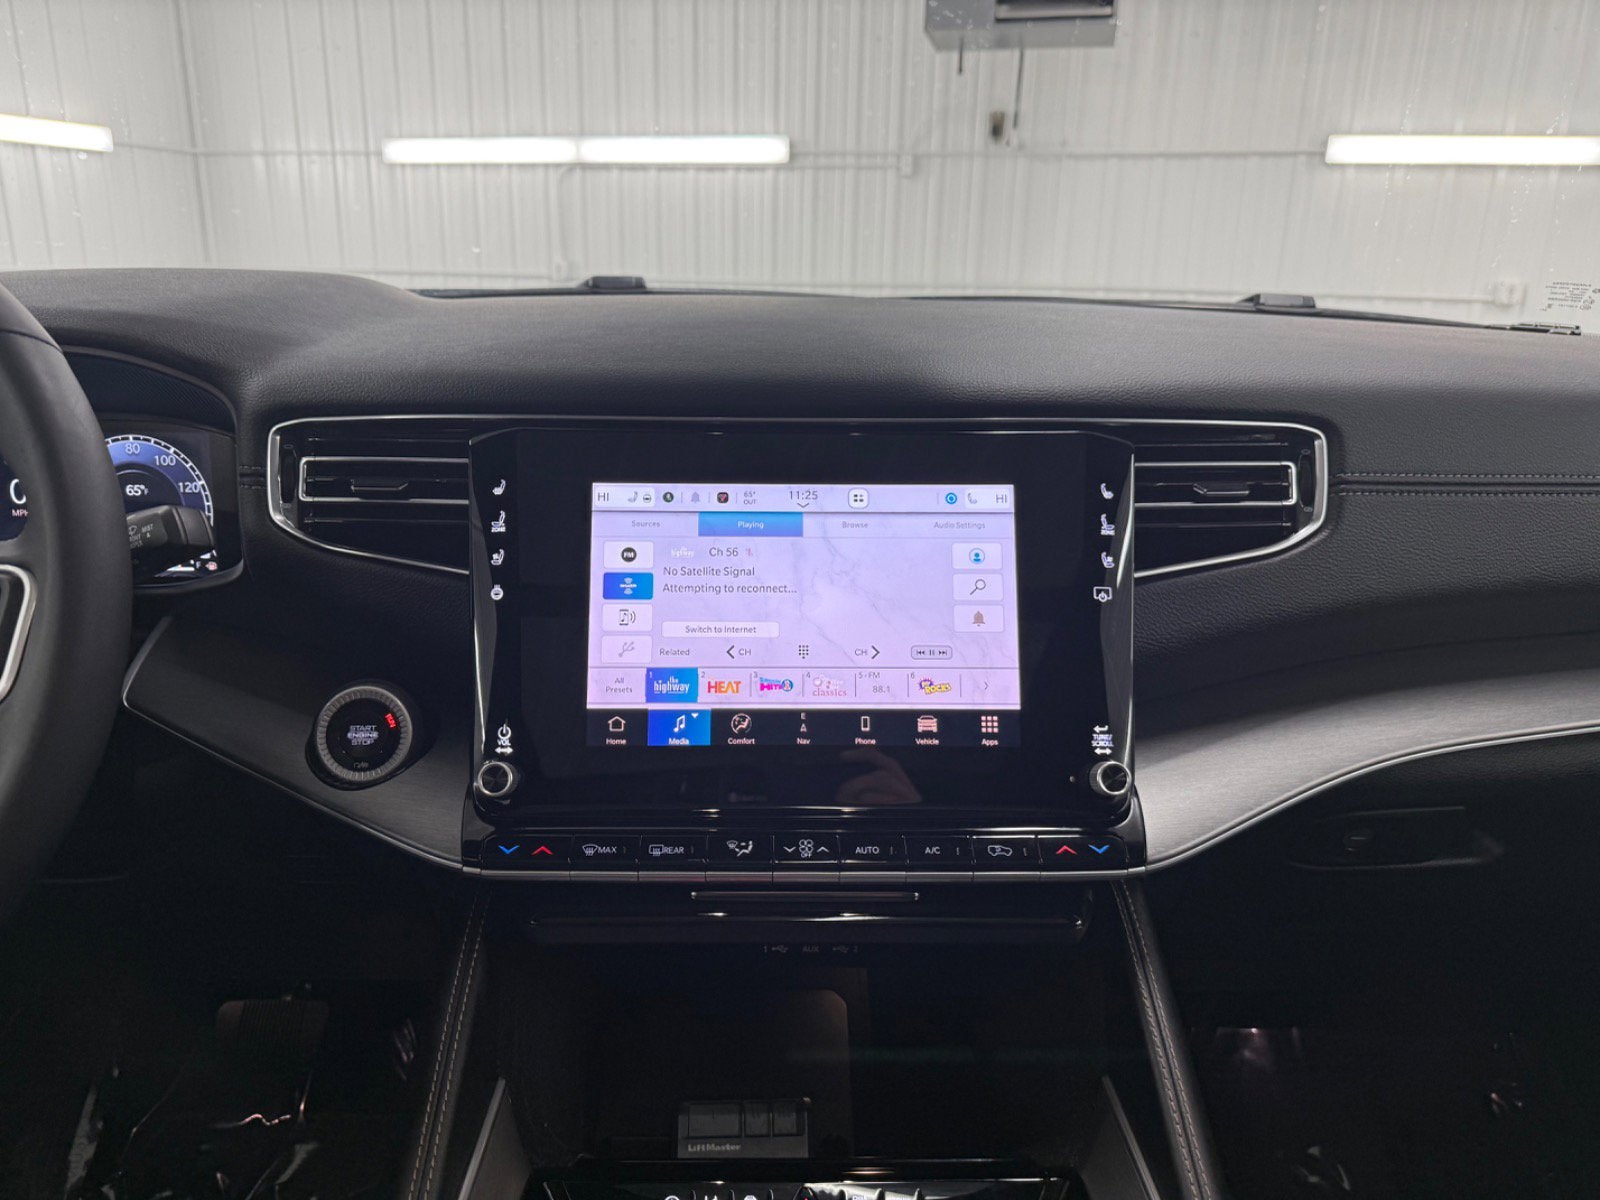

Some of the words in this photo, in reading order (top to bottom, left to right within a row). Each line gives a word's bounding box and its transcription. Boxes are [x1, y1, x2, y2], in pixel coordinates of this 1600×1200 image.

[125, 444, 140, 454] 80
[154, 455, 176, 466] 100
[178, 482, 200, 493] 120
[597, 492, 609, 501] HI
[789, 490, 818, 500] 11:25
[996, 494, 1008, 504] HI
[631, 520, 660, 528] Sources
[737, 521, 764, 530] Playing
[842, 521, 868, 529] Browse
[934, 521, 954, 529] Audio
[956, 521, 986, 530] Settings
[709, 548, 723, 557] Ch
[726, 548, 738, 557] 56
[663, 567, 678, 576] No
[680, 566, 721, 576] Satellite
[723, 566, 755, 578] Signal
[662, 584, 721, 594] Attempting
[724, 585, 735, 593] to
[685, 625, 712, 634] Switch
[724, 625, 757, 634] Internet
[659, 648, 690, 656] Related
[654, 680, 690, 694] highway
[707, 681, 741, 694] HEAT
[872, 685, 890, 693] 88.1
[812, 688, 847, 697] classics
[981, 738, 999, 746] Apps
[687, 1143, 742, 1152] LiftMaster
